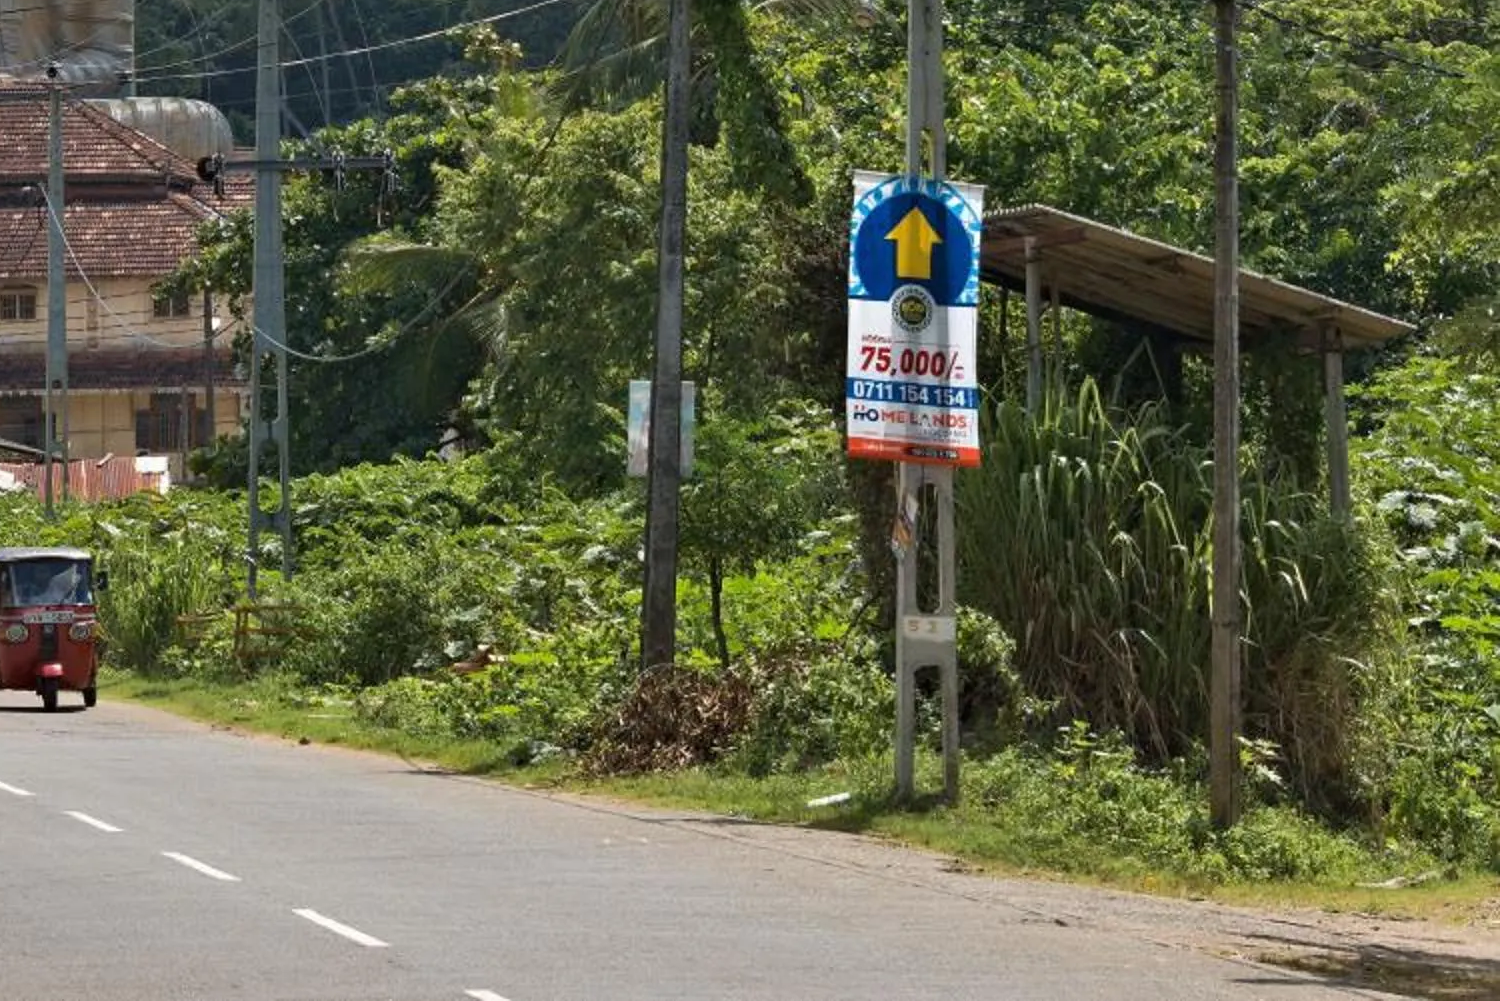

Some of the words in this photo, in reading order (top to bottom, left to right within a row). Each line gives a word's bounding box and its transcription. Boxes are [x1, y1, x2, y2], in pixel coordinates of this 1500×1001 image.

[860, 345, 964, 380] 75,000/-
[853, 380, 893, 399] 0711
[900, 384, 929, 404] 154
[934, 387, 965, 406] 154
[853, 404, 967, 429] HOMELANDS
